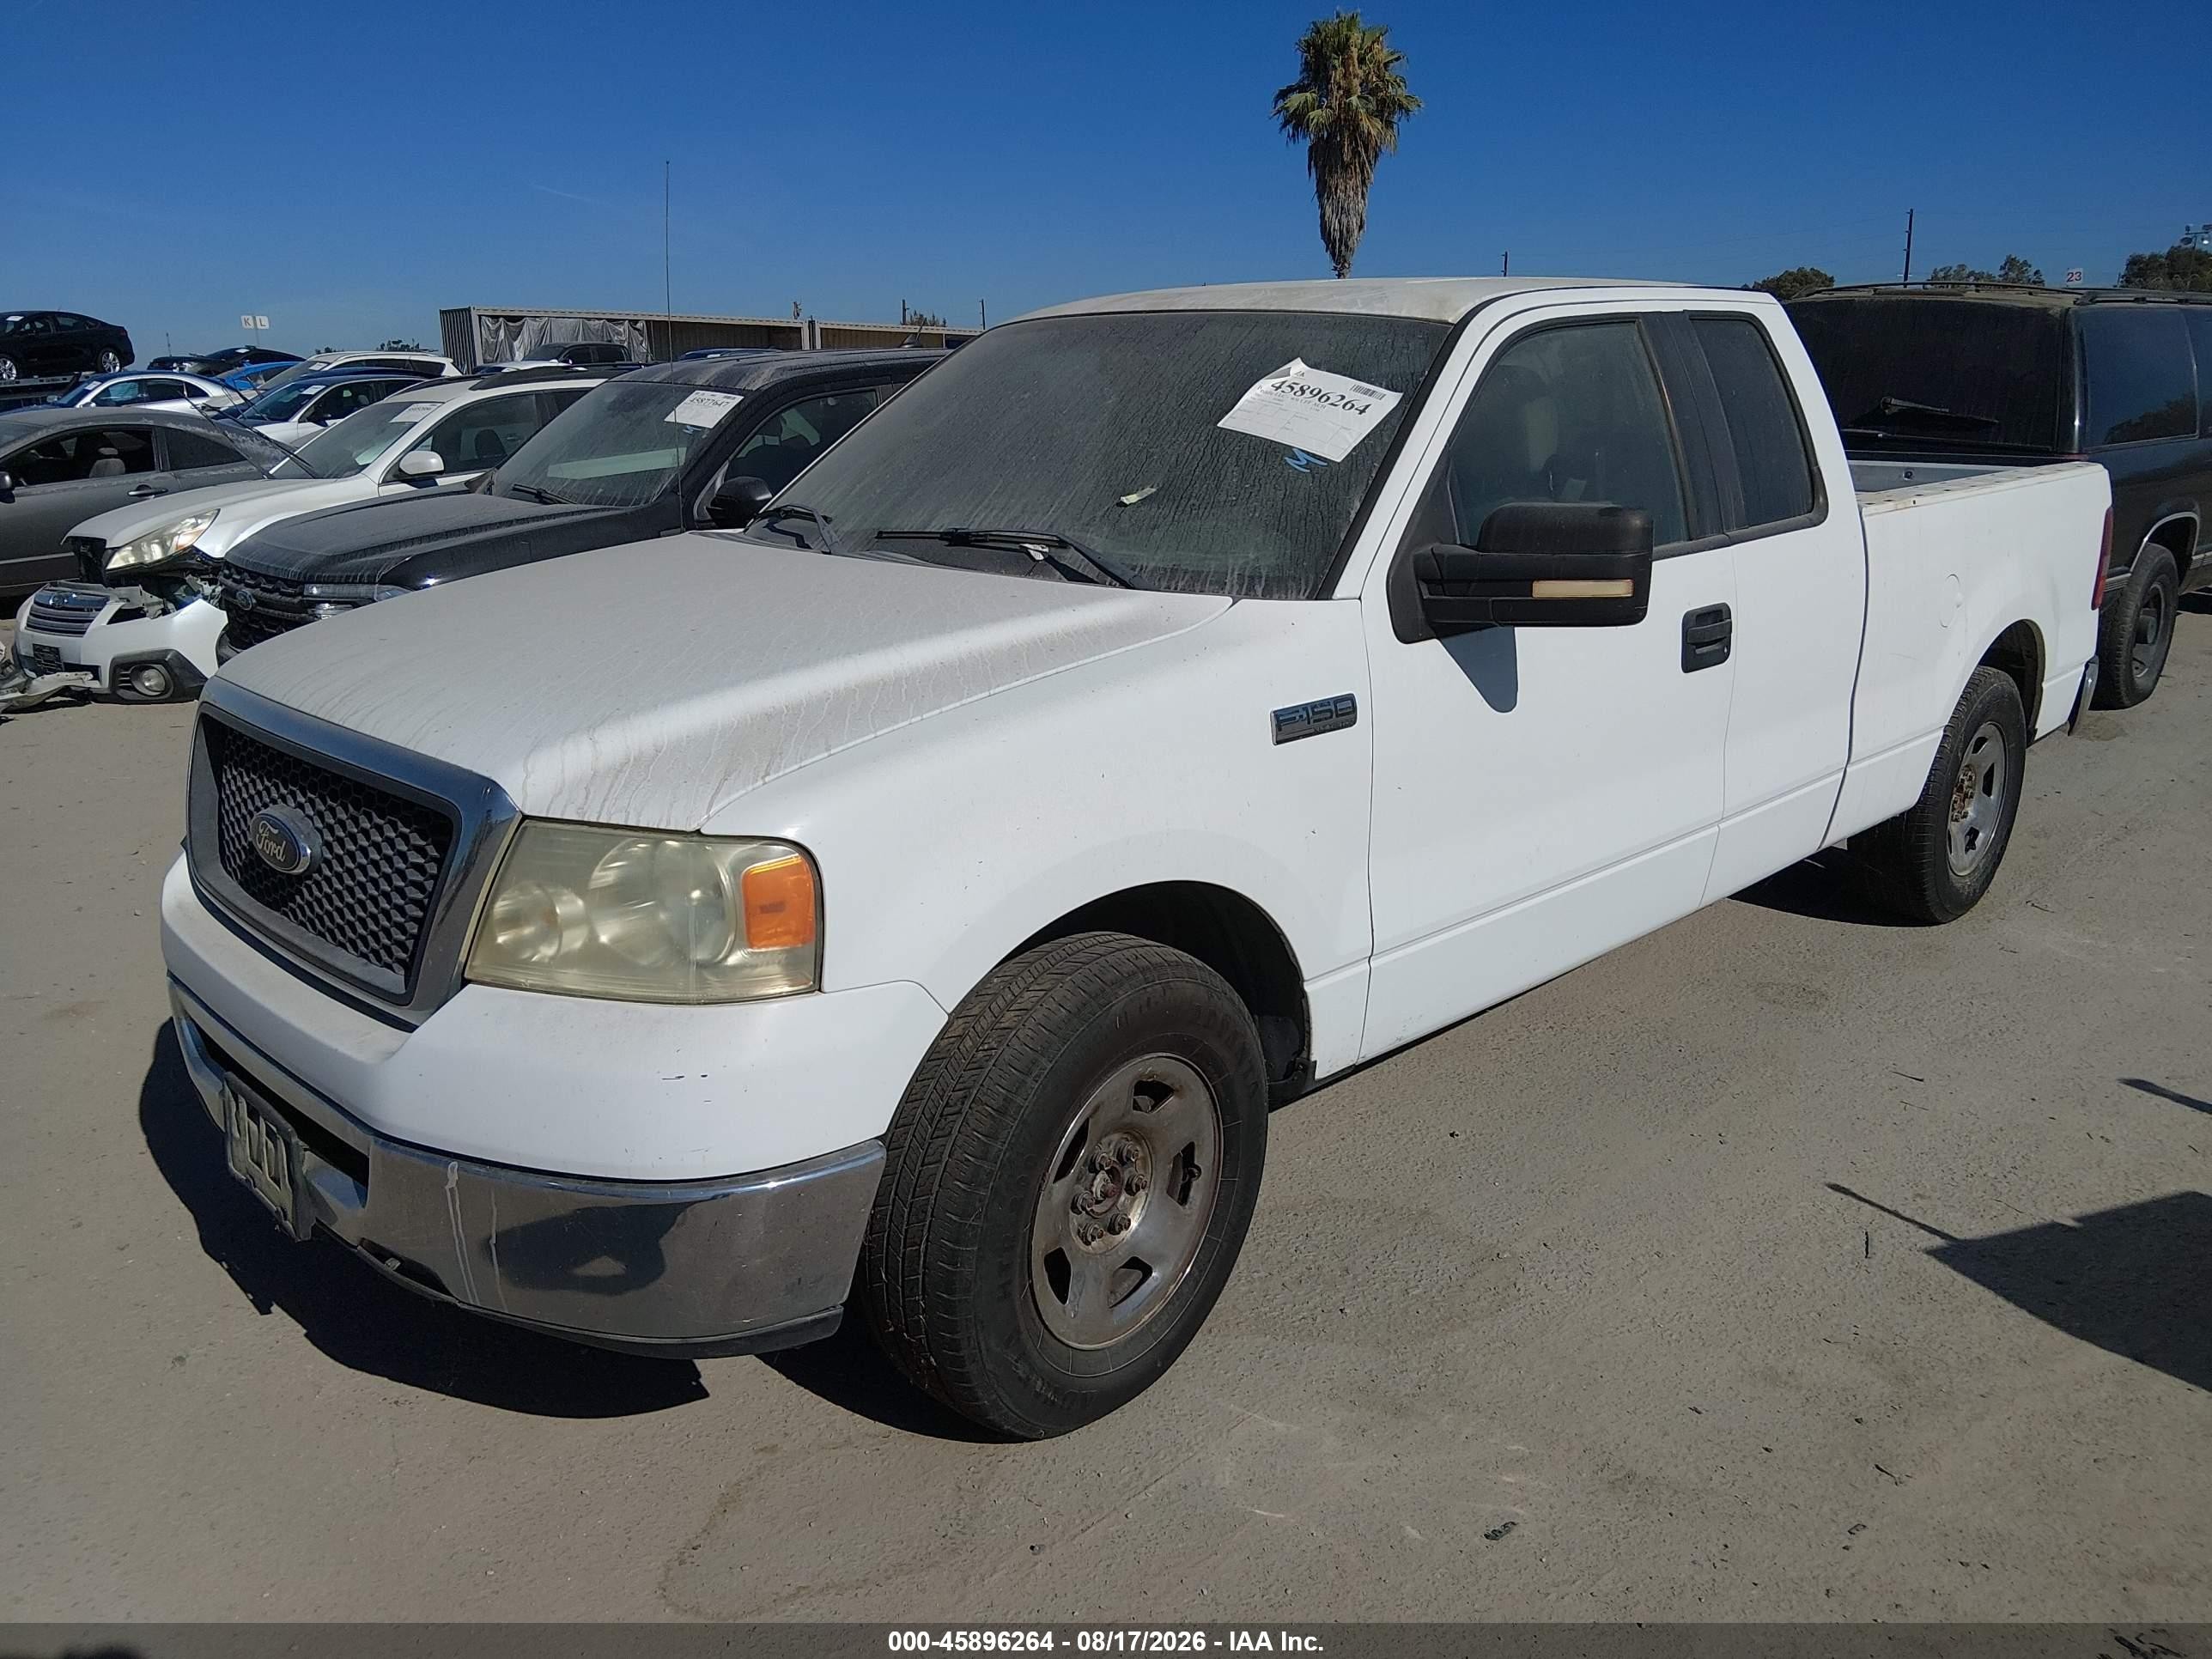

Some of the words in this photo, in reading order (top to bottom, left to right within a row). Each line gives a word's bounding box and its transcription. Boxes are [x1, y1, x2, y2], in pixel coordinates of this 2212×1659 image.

[2066, 271, 2082, 283] 23
[243, 317, 252, 326] K
[258, 317, 267, 327] L
[1271, 380, 1372, 415] 45896264
[256, 820, 287, 862] Ford
